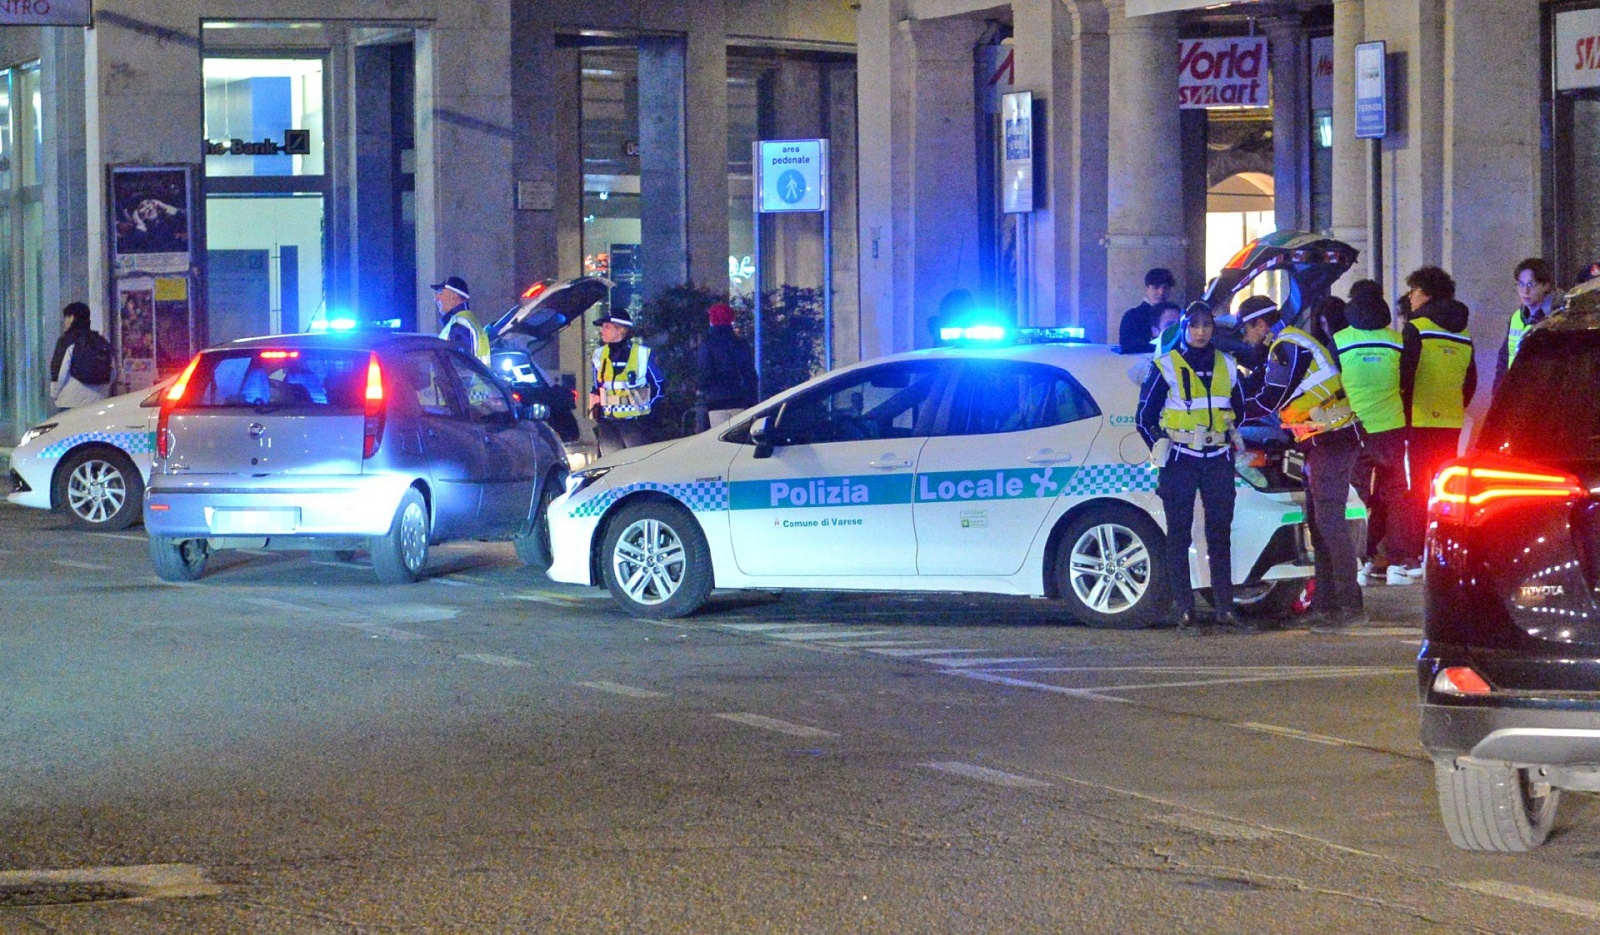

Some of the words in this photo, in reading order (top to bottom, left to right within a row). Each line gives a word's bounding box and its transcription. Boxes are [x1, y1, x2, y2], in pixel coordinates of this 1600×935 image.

[230, 138, 278, 155] Bank
[772, 156, 810, 165] pedonale
[770, 478, 869, 507] Polizia
[920, 472, 1024, 500] Locale
[783, 519, 819, 527] Comune
[821, 518, 830, 526] di
[831, 518, 863, 526] Varese
[1520, 585, 1564, 596] TOYOTA
